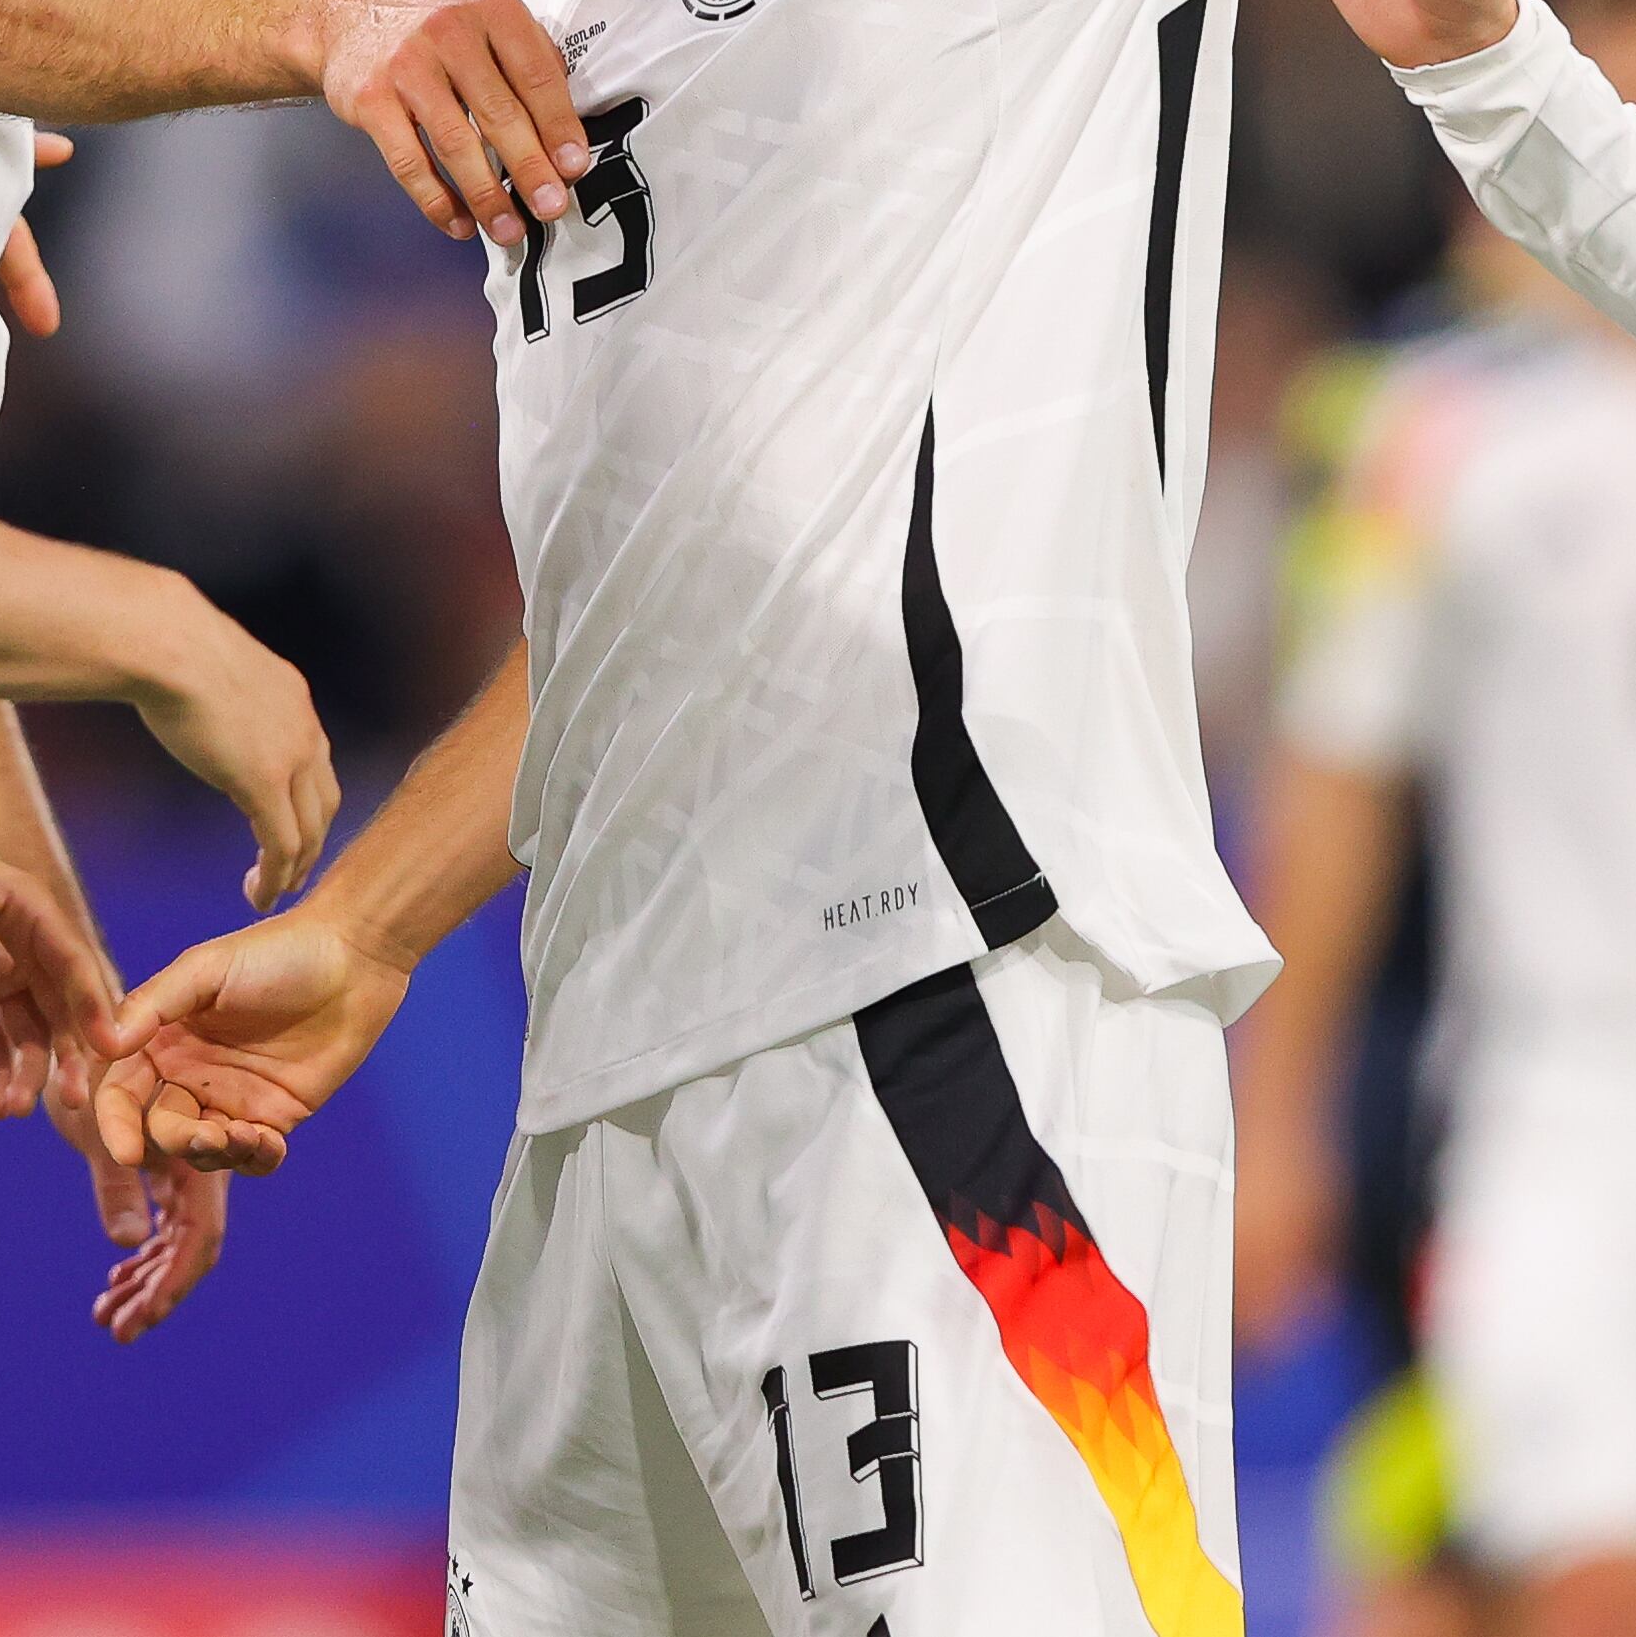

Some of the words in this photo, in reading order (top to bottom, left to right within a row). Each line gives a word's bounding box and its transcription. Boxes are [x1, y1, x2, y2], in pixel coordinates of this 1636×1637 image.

[564, 20, 606, 50] SCOTLAND
[501, 96, 655, 344] 13
[823, 881, 918, 932] HEAT.RDY
[760, 1340, 924, 1602] 13
